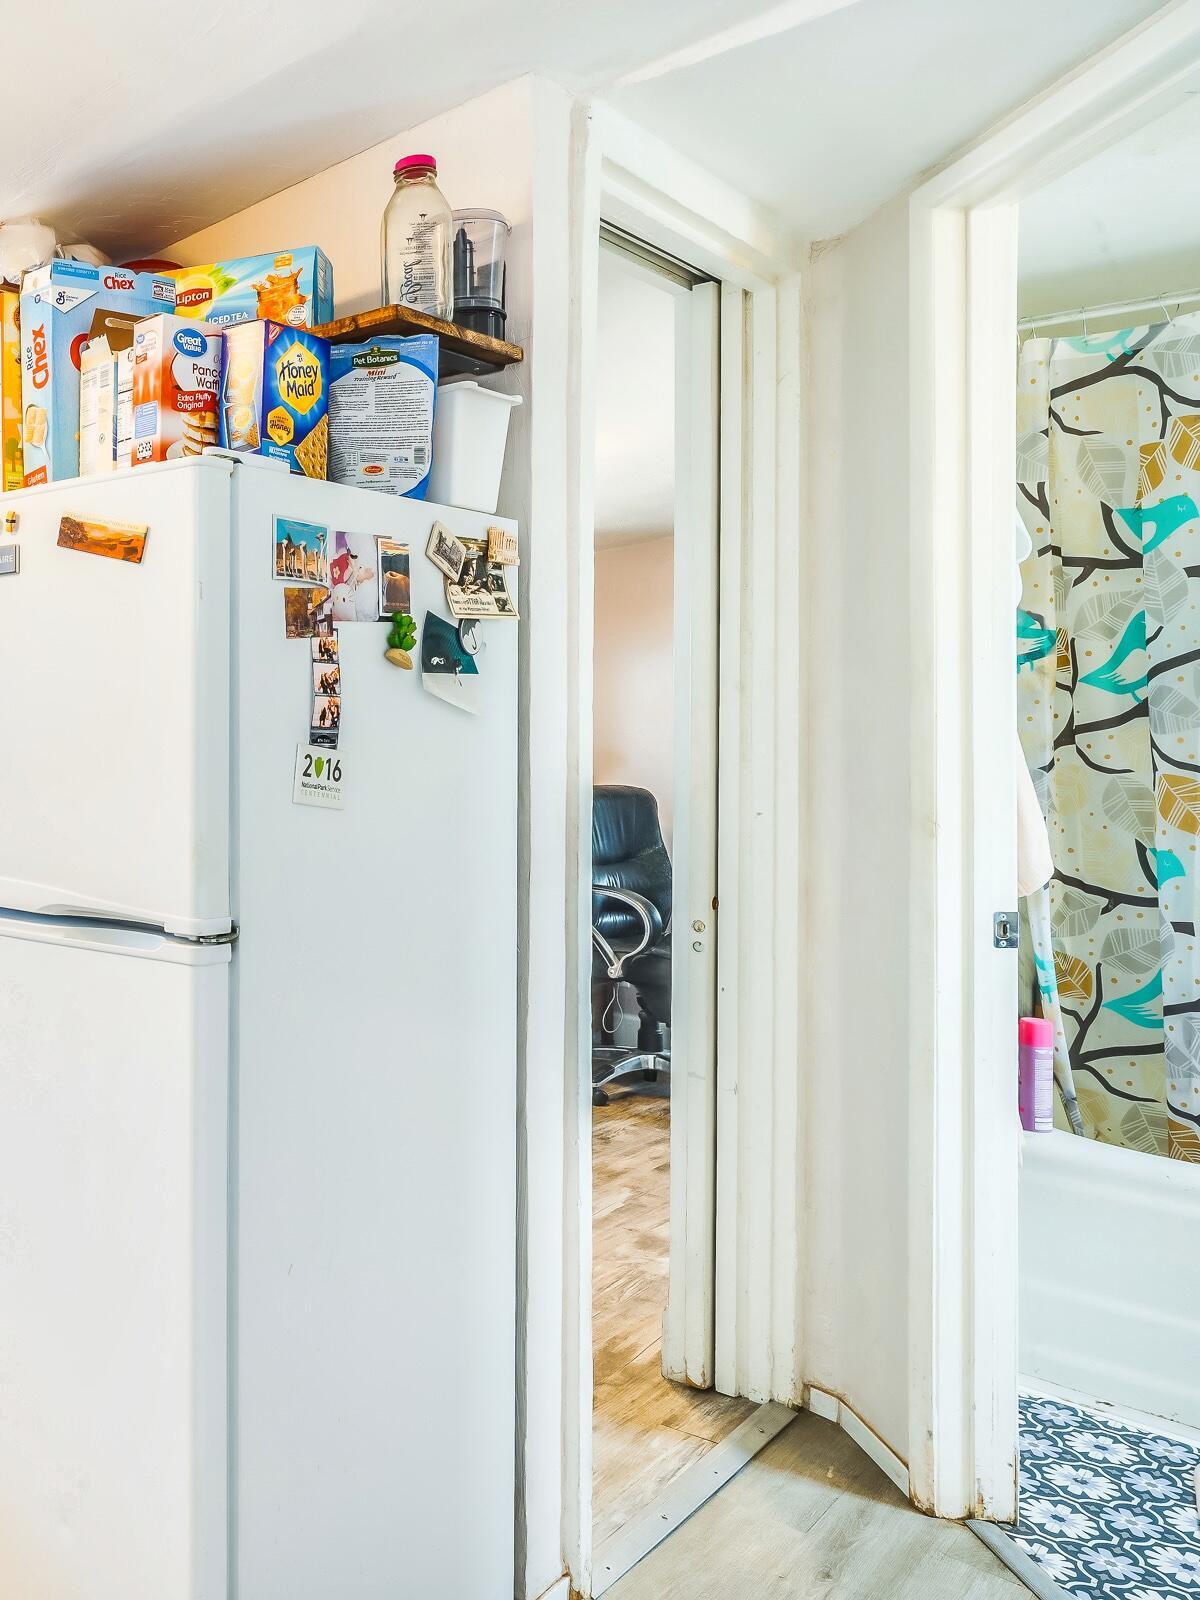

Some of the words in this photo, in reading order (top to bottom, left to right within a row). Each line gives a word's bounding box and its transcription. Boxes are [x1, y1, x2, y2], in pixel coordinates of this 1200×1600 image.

[103, 276, 136, 291] Chex
[176, 290, 210, 305] Lipton
[208, 314, 231, 325] ICED
[231, 311, 249, 321] TEA
[176, 332, 202, 347] Great
[182, 342, 202, 353] Value
[26, 345, 34, 371] Rice
[31, 323, 50, 390] Chex
[353, 357, 367, 365] Pet
[366, 354, 398, 364] Botanics
[279, 360, 319, 384] Honey
[177, 393, 194, 401] Extra
[195, 393, 212, 401] Fluffy
[286, 380, 315, 400] Maid
[176, 401, 204, 411] Original
